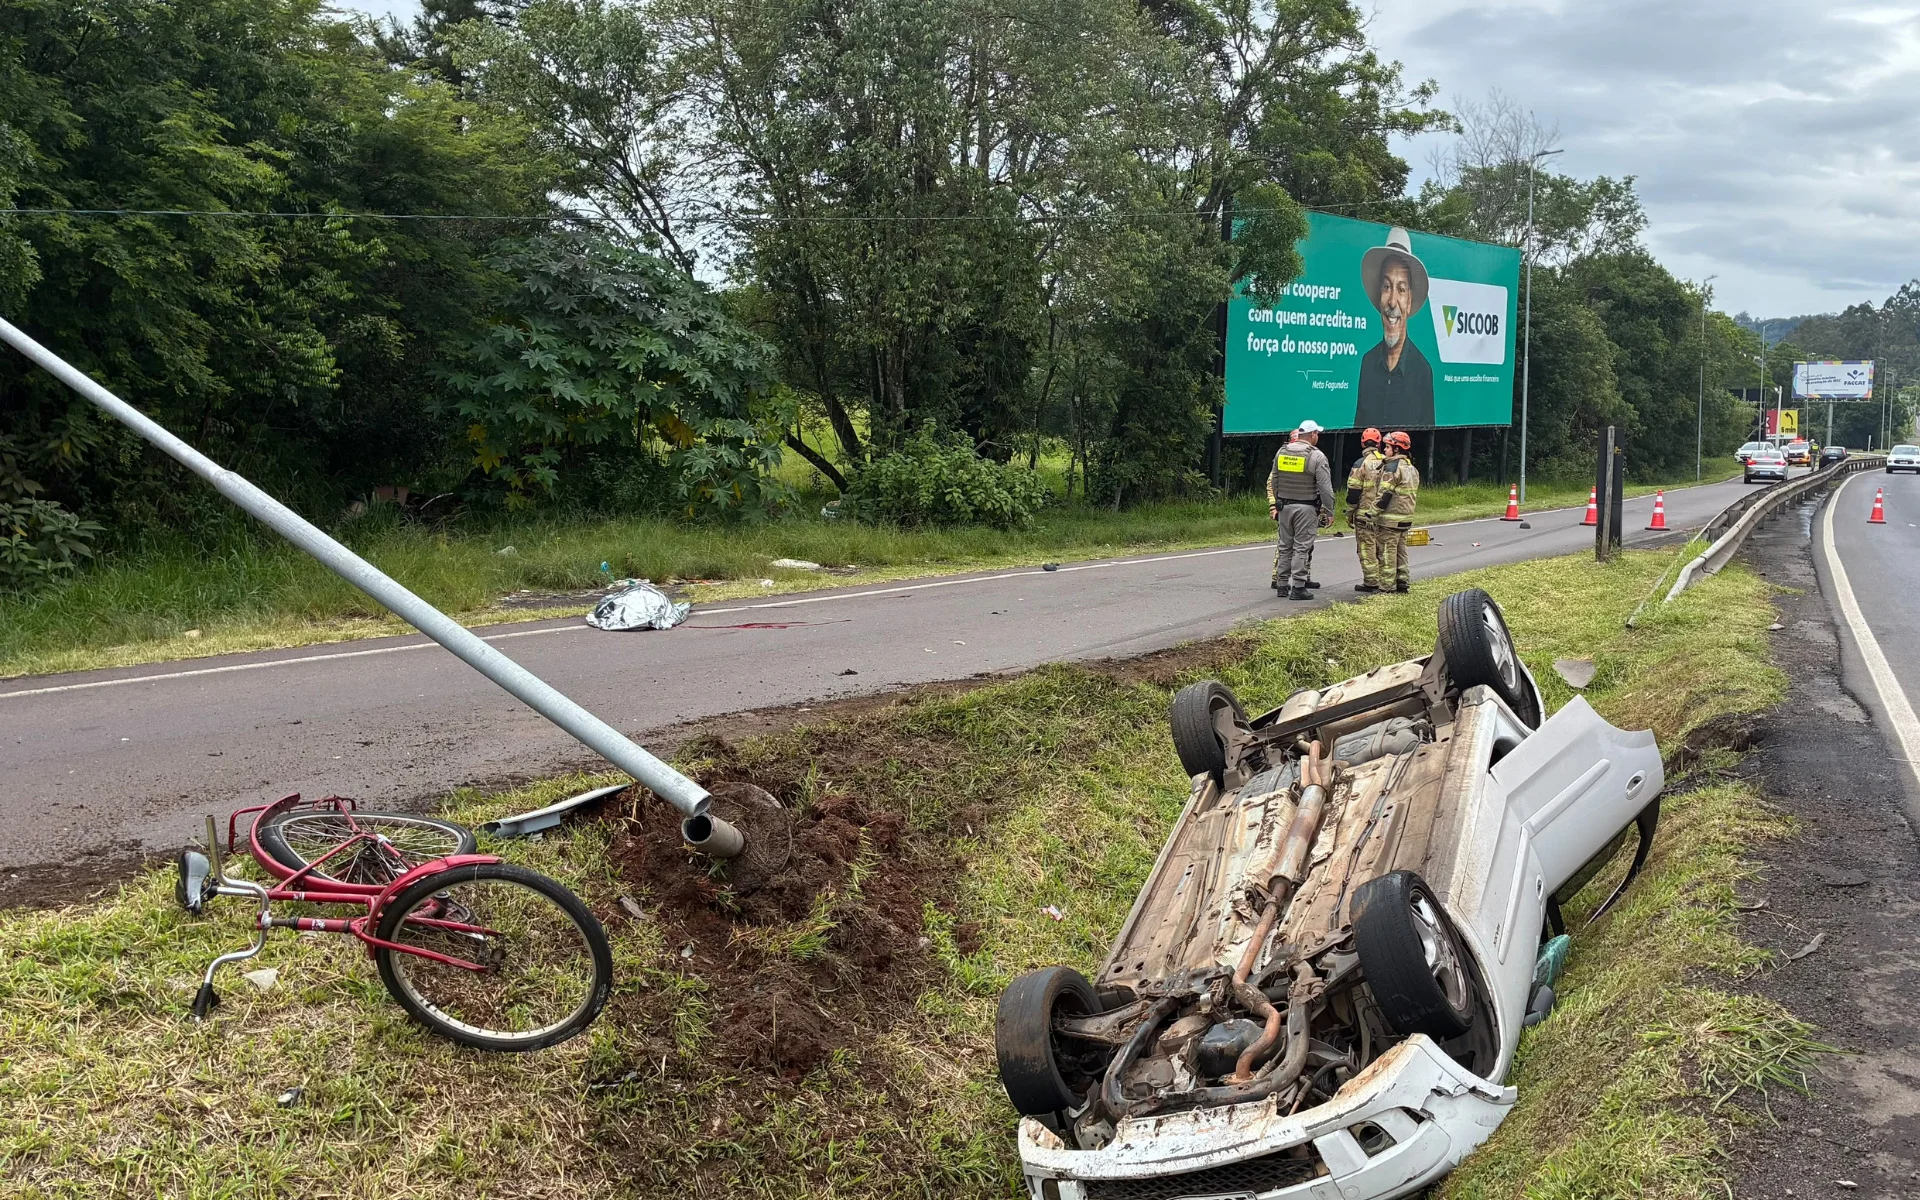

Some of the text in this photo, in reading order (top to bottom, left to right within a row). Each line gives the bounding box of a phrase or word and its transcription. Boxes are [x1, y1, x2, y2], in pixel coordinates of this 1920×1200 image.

[1292, 283, 1341, 303] cooperar
[1248, 308, 1367, 330] com quem acredita na
[1457, 311, 1499, 336] SICOOB
[1247, 331, 1358, 360] força do nosso povo.
[1325, 380, 1349, 392] Fagundes
[1785, 425, 1797, 433] min
